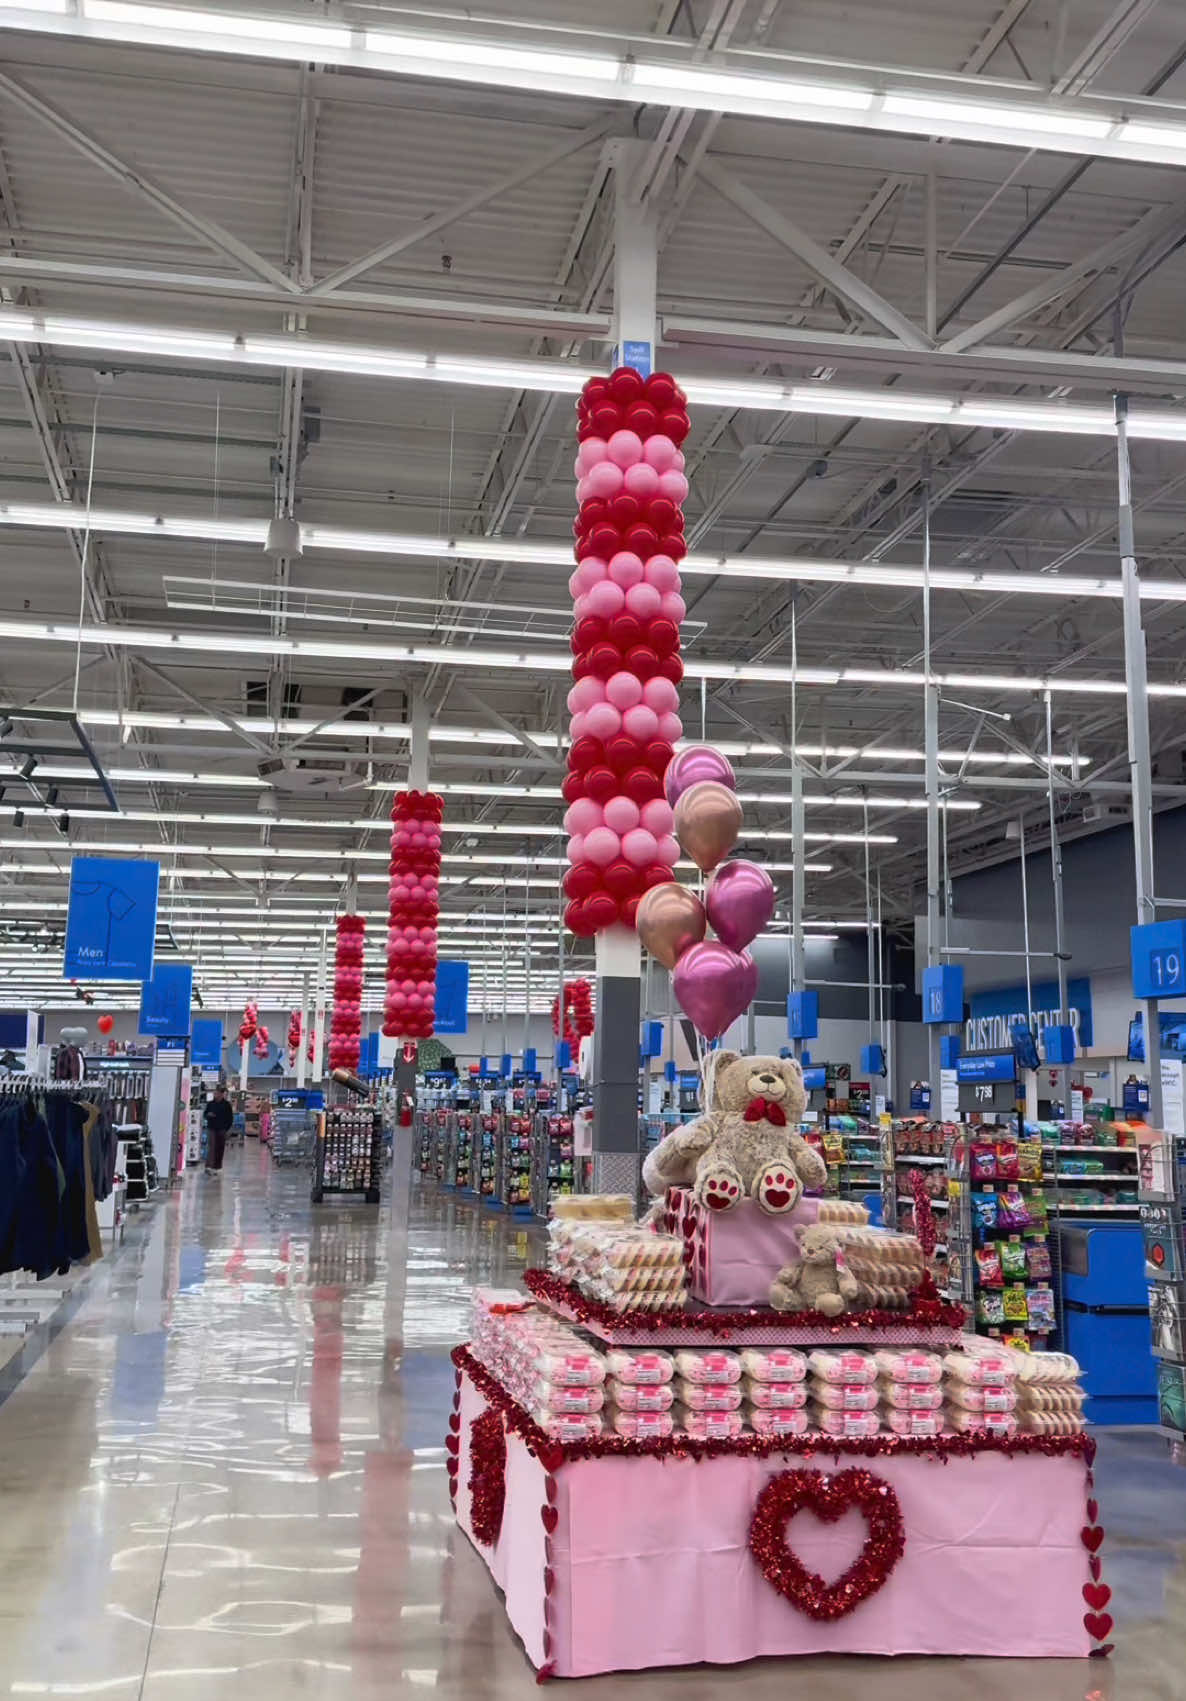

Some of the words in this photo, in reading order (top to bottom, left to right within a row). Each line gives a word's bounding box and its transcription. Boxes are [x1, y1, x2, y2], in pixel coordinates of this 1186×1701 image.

[78, 946, 104, 958] Men
[1152, 953, 1180, 985] 19
[930, 991, 944, 1015] 18
[1030, 1007, 1081, 1049] CER
